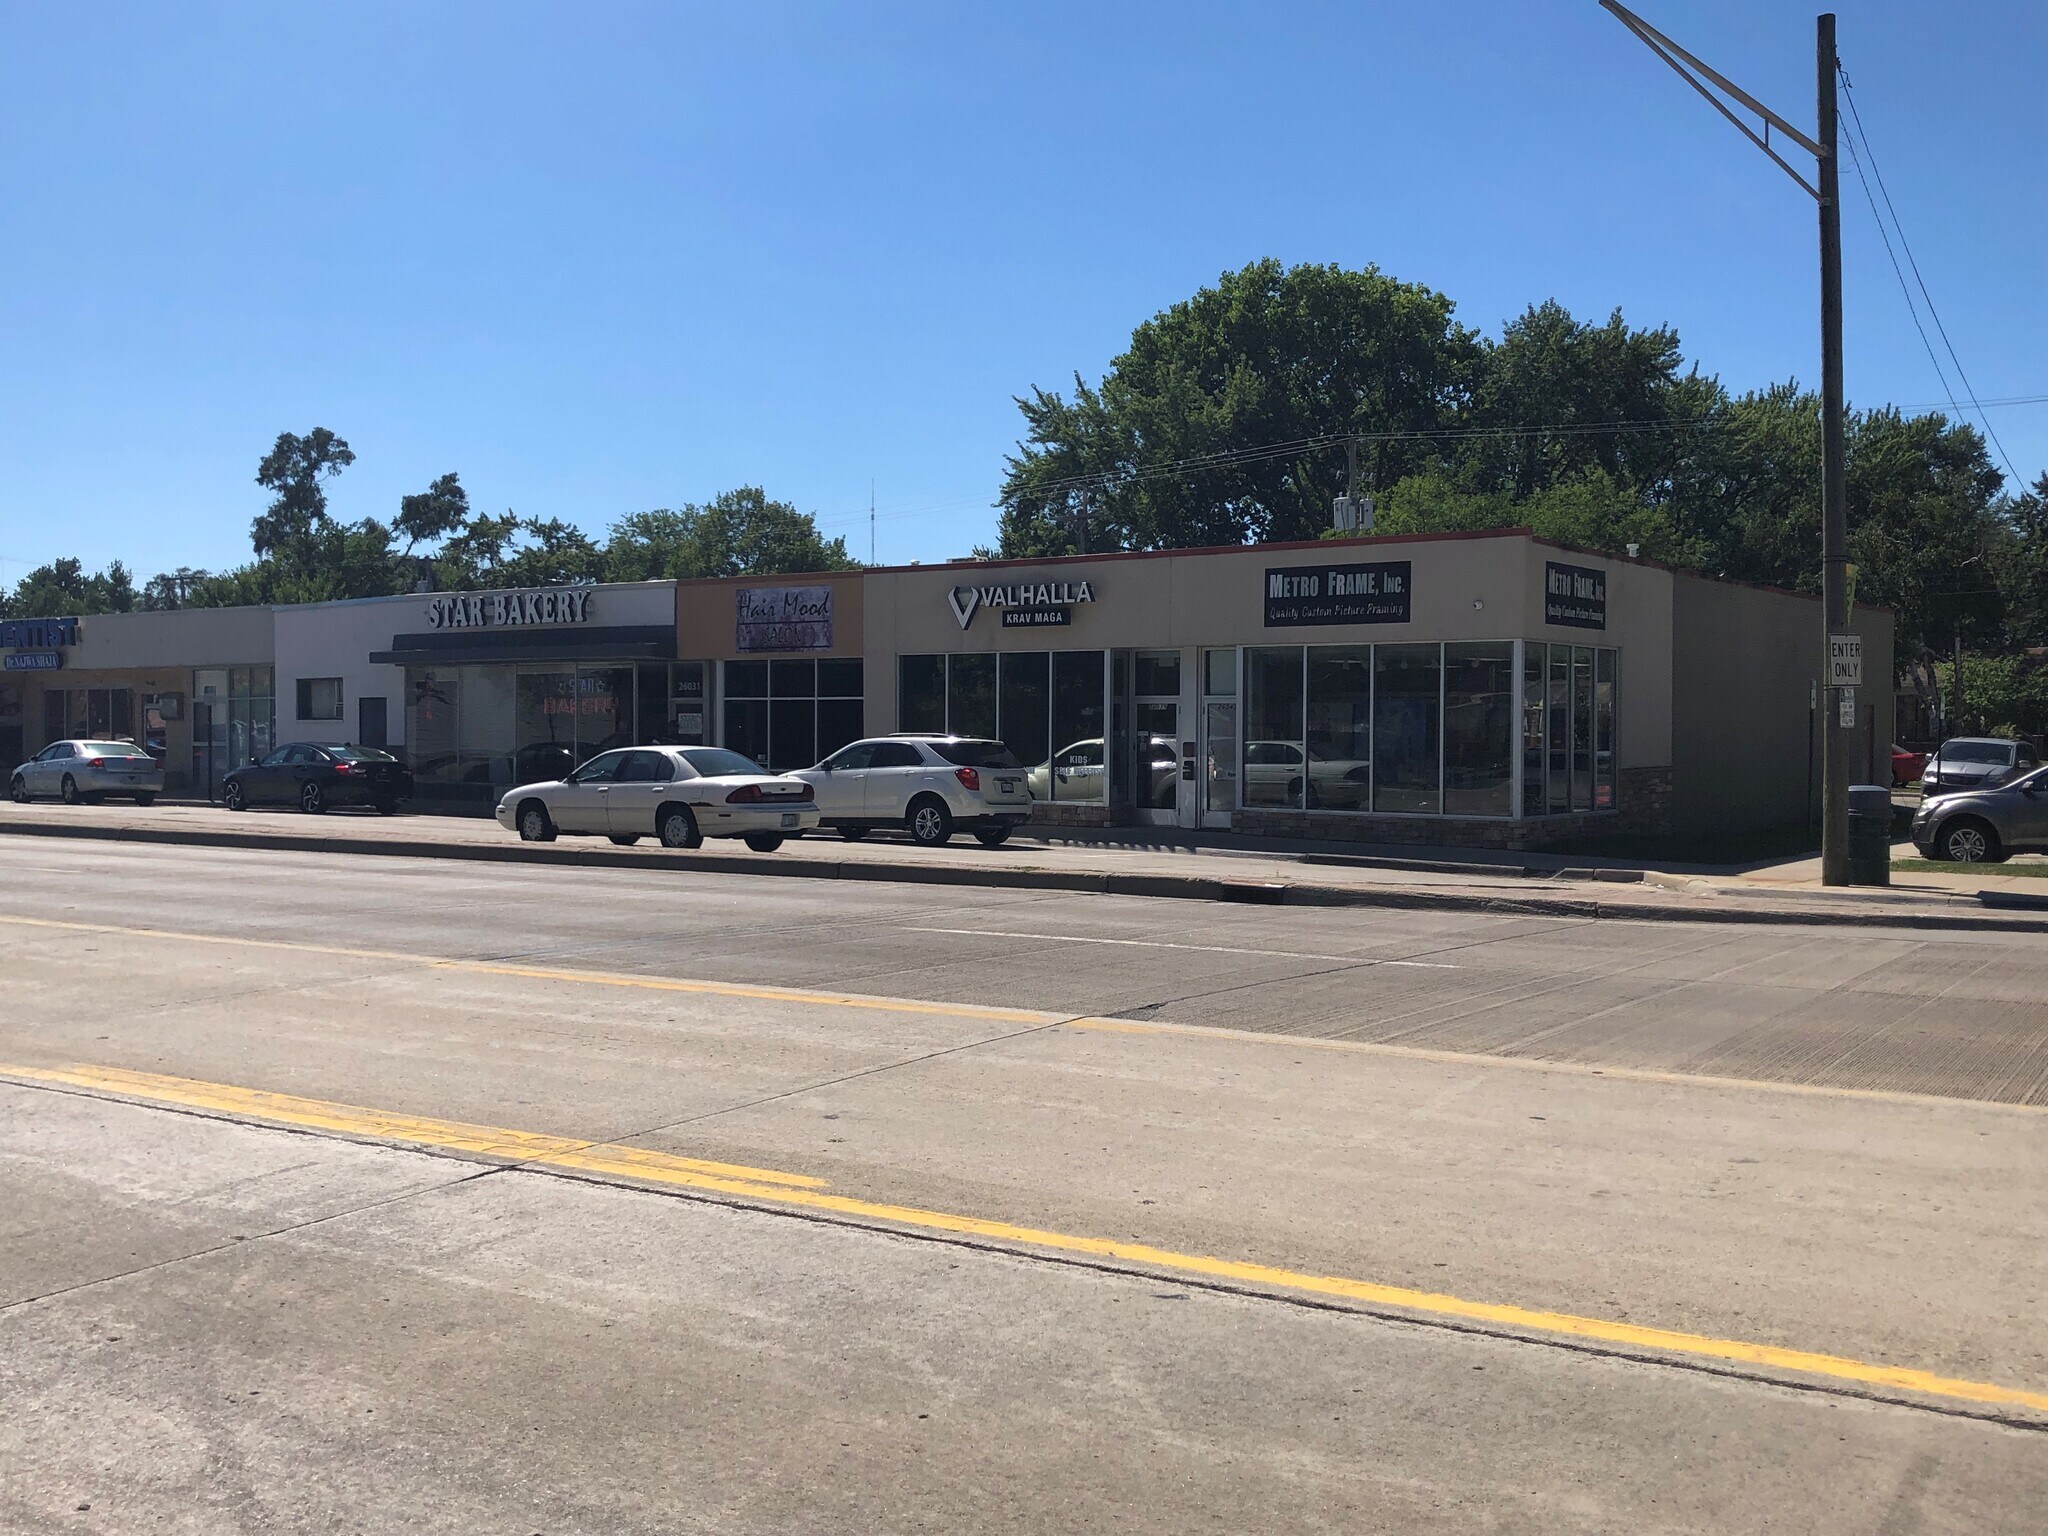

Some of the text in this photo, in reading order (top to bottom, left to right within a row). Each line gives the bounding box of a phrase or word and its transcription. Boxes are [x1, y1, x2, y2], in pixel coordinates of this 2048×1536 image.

[1269, 574, 1319, 599] METRO
[1328, 571, 1379, 597] FRAME,
[980, 581, 1092, 607] VALHALLA
[428, 590, 589, 628] STAR BAKERY
[740, 591, 830, 619] Hair Mood
[1270, 602, 1404, 620] Quality Custom Picture Framing
[1006, 611, 1063, 624] KRAV MAGA
[0, 618, 77, 647] ENTIST
[1832, 643, 1861, 658] ENTER
[1835, 662, 1859, 678] ONLY
[569, 678, 594, 694] SAR
[678, 681, 700, 691] 26031
[1069, 755, 1088, 764] KIDS
